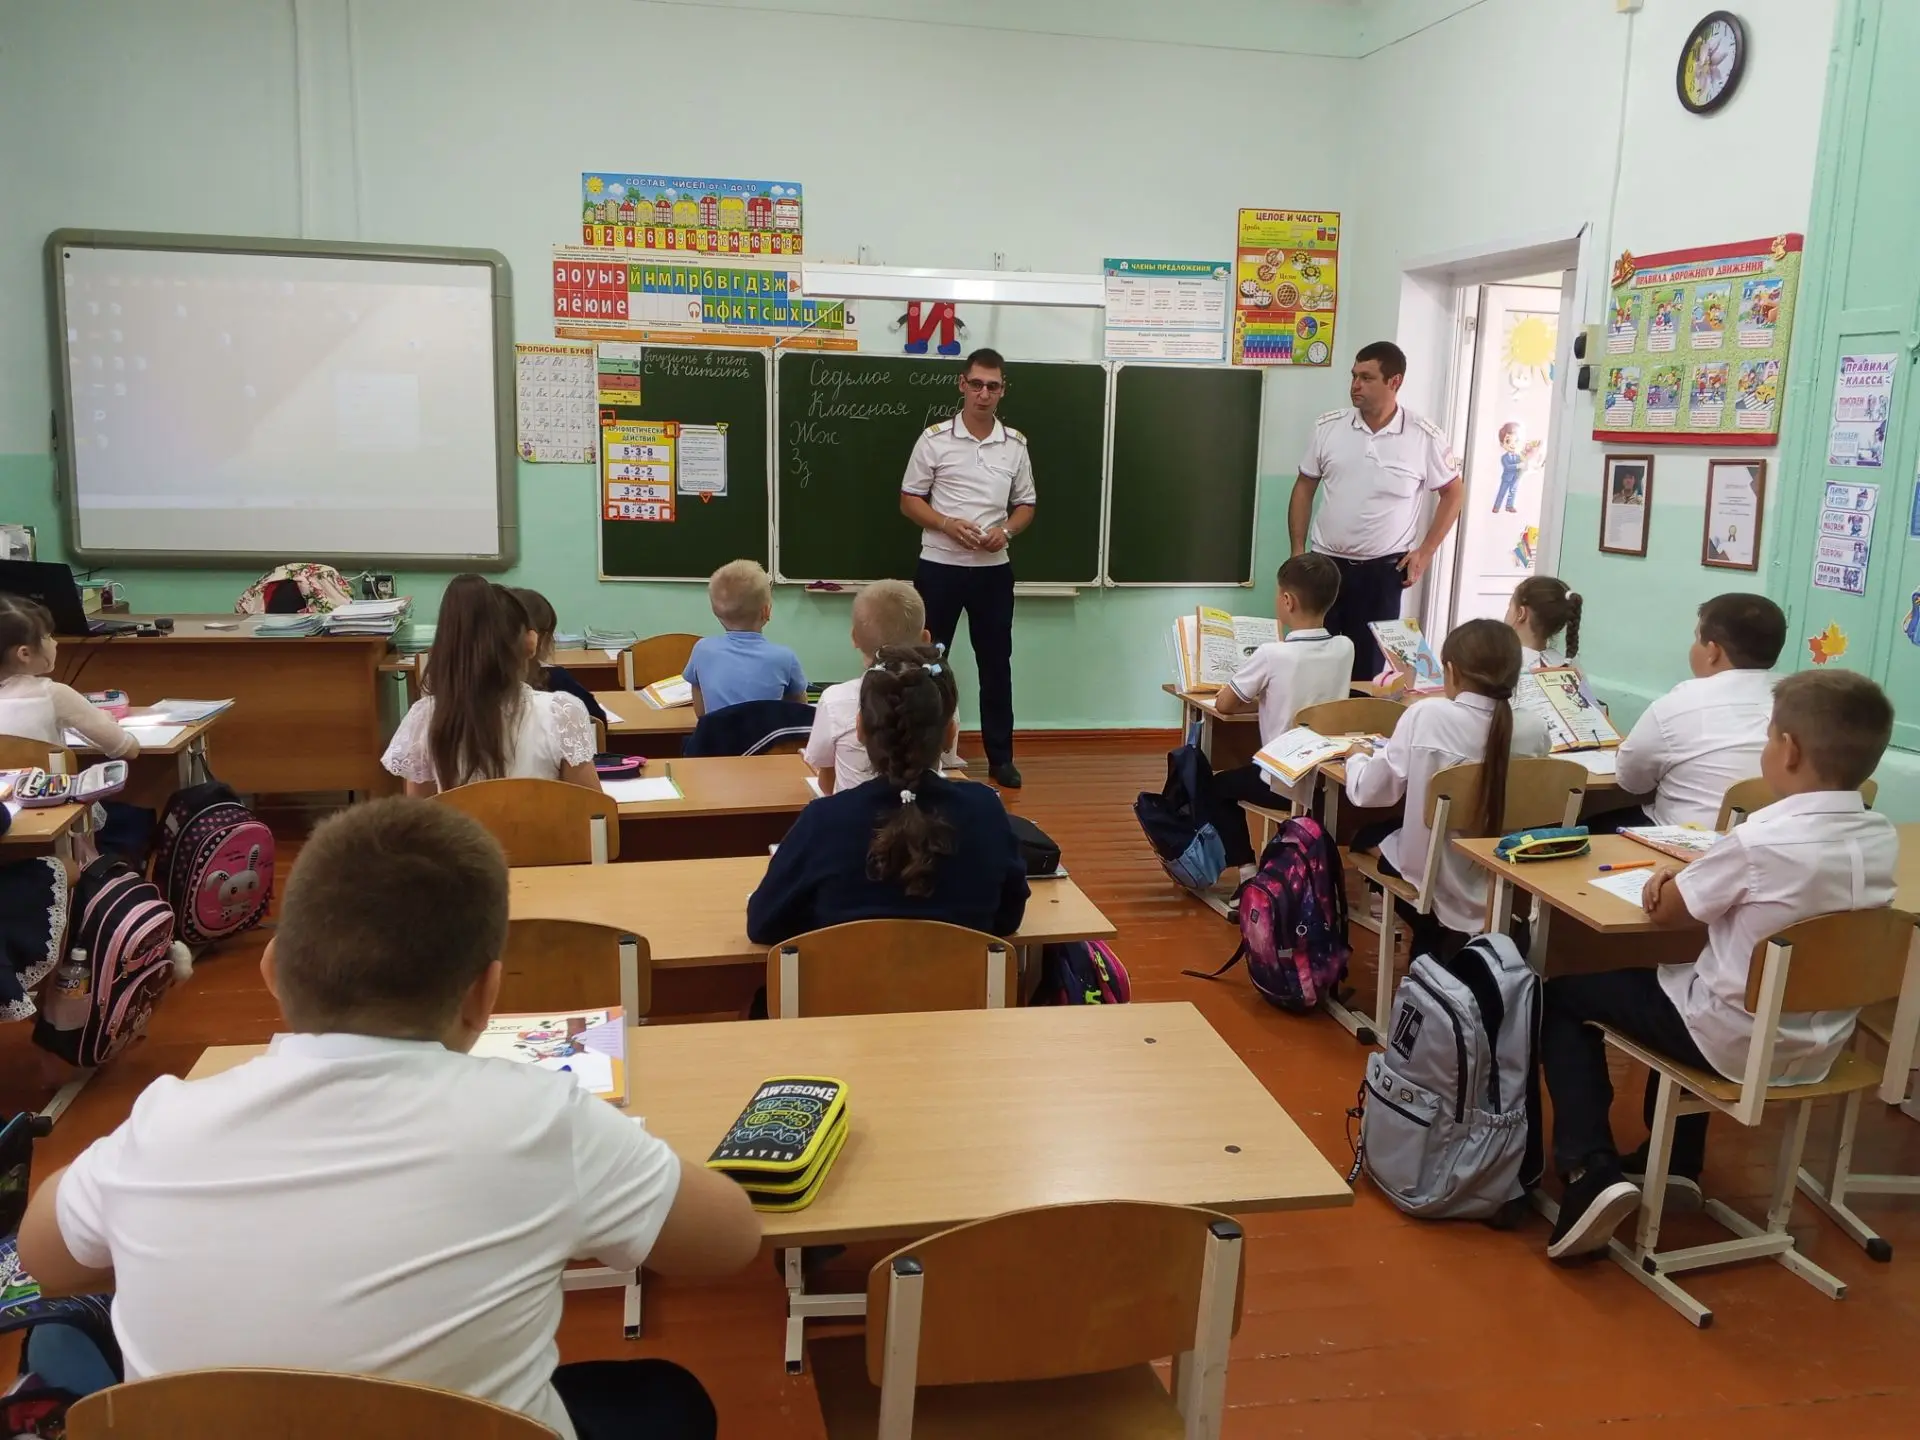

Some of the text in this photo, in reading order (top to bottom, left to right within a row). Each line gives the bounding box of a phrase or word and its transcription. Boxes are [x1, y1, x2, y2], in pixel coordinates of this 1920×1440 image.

[626, 178, 666, 188] СОСТАВ
[672, 180, 706, 189] ЧИСЕЛ
[730, 184, 742, 192] до
[746, 184, 757, 192] 10
[1256, 212, 1324, 223] ЦЕЛОЕ И ЧАСТЬ
[585, 228, 592, 240] 0
[597, 229, 601, 241] 1
[606, 229, 612, 241] 2
[616, 229, 622, 241] 3
[626, 229, 633, 242] 4
[647, 230, 654, 242] 6
[667, 231, 674, 244] 8
[678, 231, 684, 244] 9
[687, 232, 696, 244] 10
[698, 232, 706, 244] 11
[708, 232, 717, 245] 12
[729, 233, 739, 246] 14
[751, 234, 760, 247] 16
[772, 236, 781, 249] 18
[783, 236, 792, 249] 19
[1157, 264, 1211, 272] ПРЕДЛОЖЕНИЯ
[1636, 260, 1763, 286] ПРАВИЛА ДОРОЖНОГО ДВИЖЕНИЯ
[516, 346, 568, 354] ПРОПИСНЫЕ
[1846, 362, 1889, 372] ПРАВИЛА
[810, 359, 893, 399] Седьмое
[1845, 376, 1883, 385] КЛАССА
[808, 390, 910, 420] Классная
[608, 426, 666, 434] АРИФМЕТИЧЕСКИ
[622, 434, 656, 442] ДЕЙСТВИЯ
[1416, 653, 1442, 680] 2
[755, 1084, 838, 1100] AWESOME
[720, 1149, 794, 1160] PLAYER
